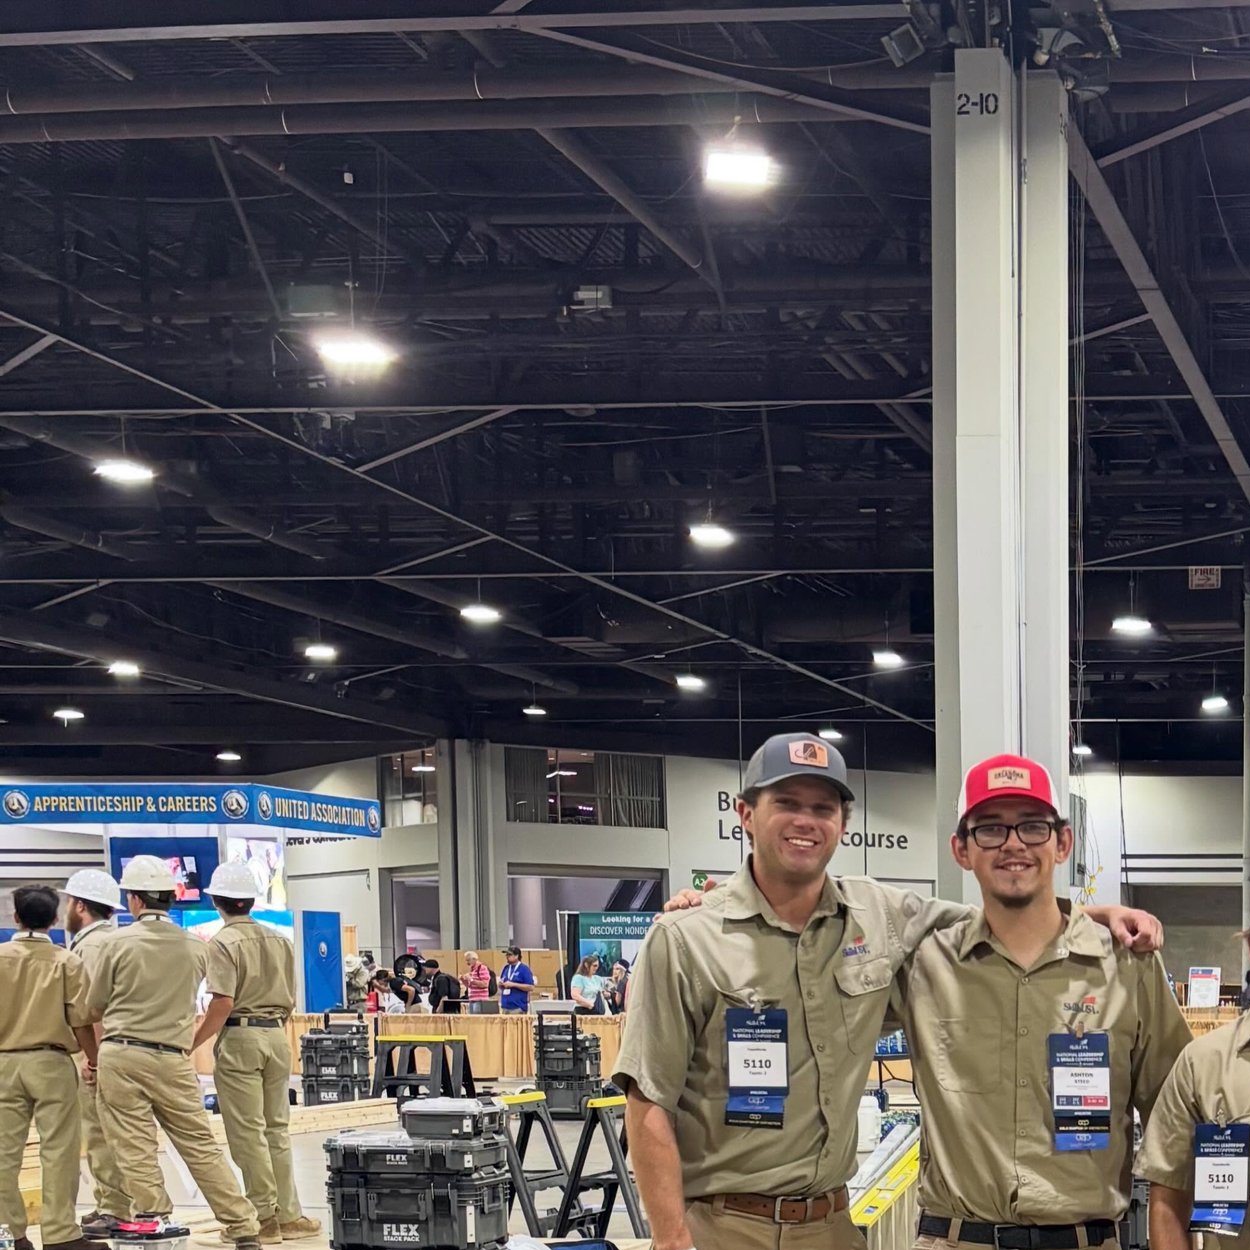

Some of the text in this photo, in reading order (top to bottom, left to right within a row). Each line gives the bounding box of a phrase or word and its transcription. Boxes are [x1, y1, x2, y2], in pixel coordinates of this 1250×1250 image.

[956, 92, 999, 116] 2-10
[33, 796, 217, 812] APPRENTICESHIP & CAREERS
[274, 797, 366, 828] UNITED ASSOCIATION
[602, 915, 631, 924] Looking
[633, 915, 643, 923] for
[590, 926, 623, 935] DISCOVER
[743, 1059, 772, 1069] 5110
[386, 1154, 408, 1162] FLEX
[1208, 1173, 1234, 1183] 5110
[383, 1223, 420, 1236] FLEX
